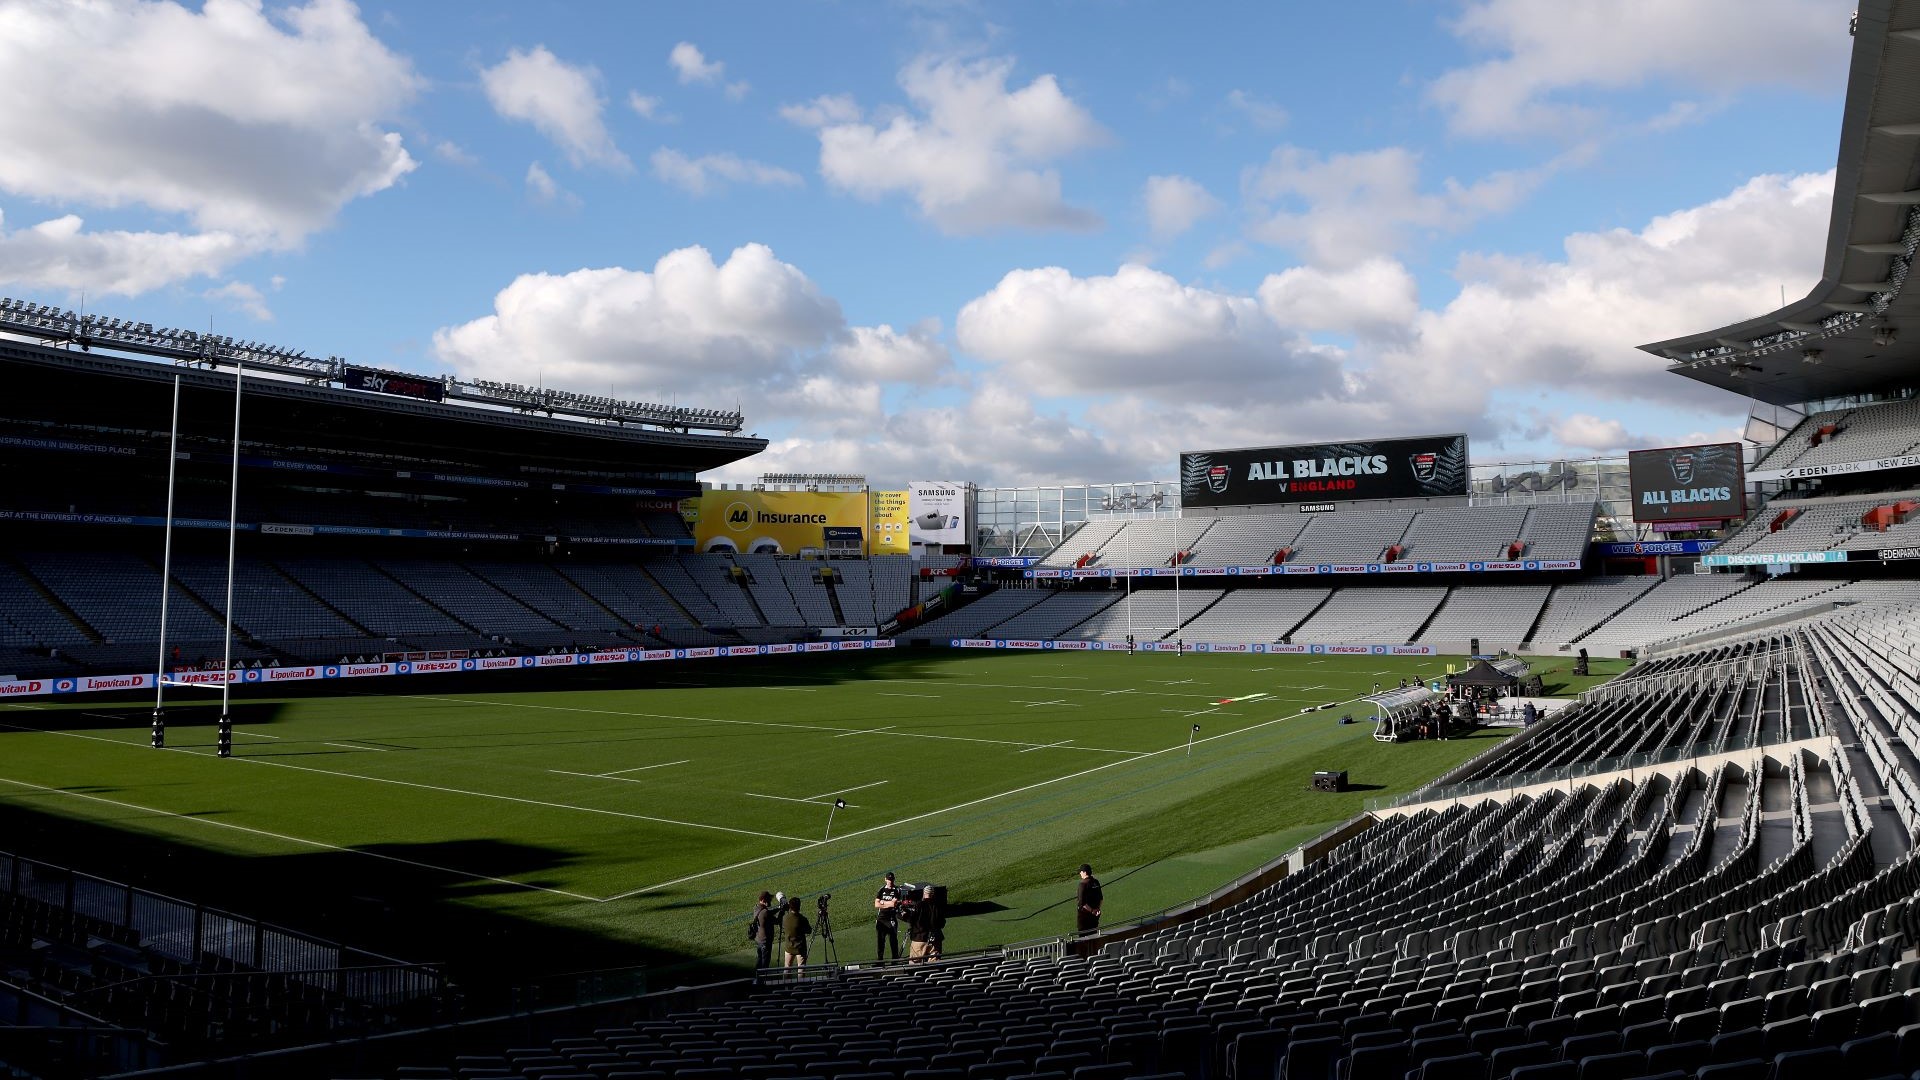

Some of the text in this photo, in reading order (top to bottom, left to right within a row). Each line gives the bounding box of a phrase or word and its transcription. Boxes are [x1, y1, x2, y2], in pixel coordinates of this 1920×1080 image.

[362, 373, 389, 392] sky
[49, 440, 57, 448] IN
[60, 441, 107, 453] UNEXPECTED
[109, 447, 136, 455] PLACES
[273, 460, 328, 471] FOR EVERY WORLD
[1248, 455, 1388, 481] ALL BLACKS
[1800, 463, 1860, 476] EDEN PARK
[1877, 459, 1899, 469] NEW
[1290, 479, 1356, 493] ENGLAND
[1642, 487, 1731, 505] ALL BLACKS
[636, 501, 673, 509] RICOH
[1300, 504, 1335, 512] SAMSUNG
[41, 513, 81, 521] UNIVERSITY
[729, 510, 827, 524] AA Insurance
[1727, 552, 1826, 565] DISCOVER AUCKLAND
[930, 568, 948, 576] KFC
[1421, 646, 1430, 654] D
[509, 658, 516, 666] D
[565, 655, 572, 663] D
[270, 668, 315, 680] Lipovitan D
[348, 664, 389, 675] Lipovitan D
[28, 681, 42, 692] D
[87, 676, 144, 690] Lipovitan D
